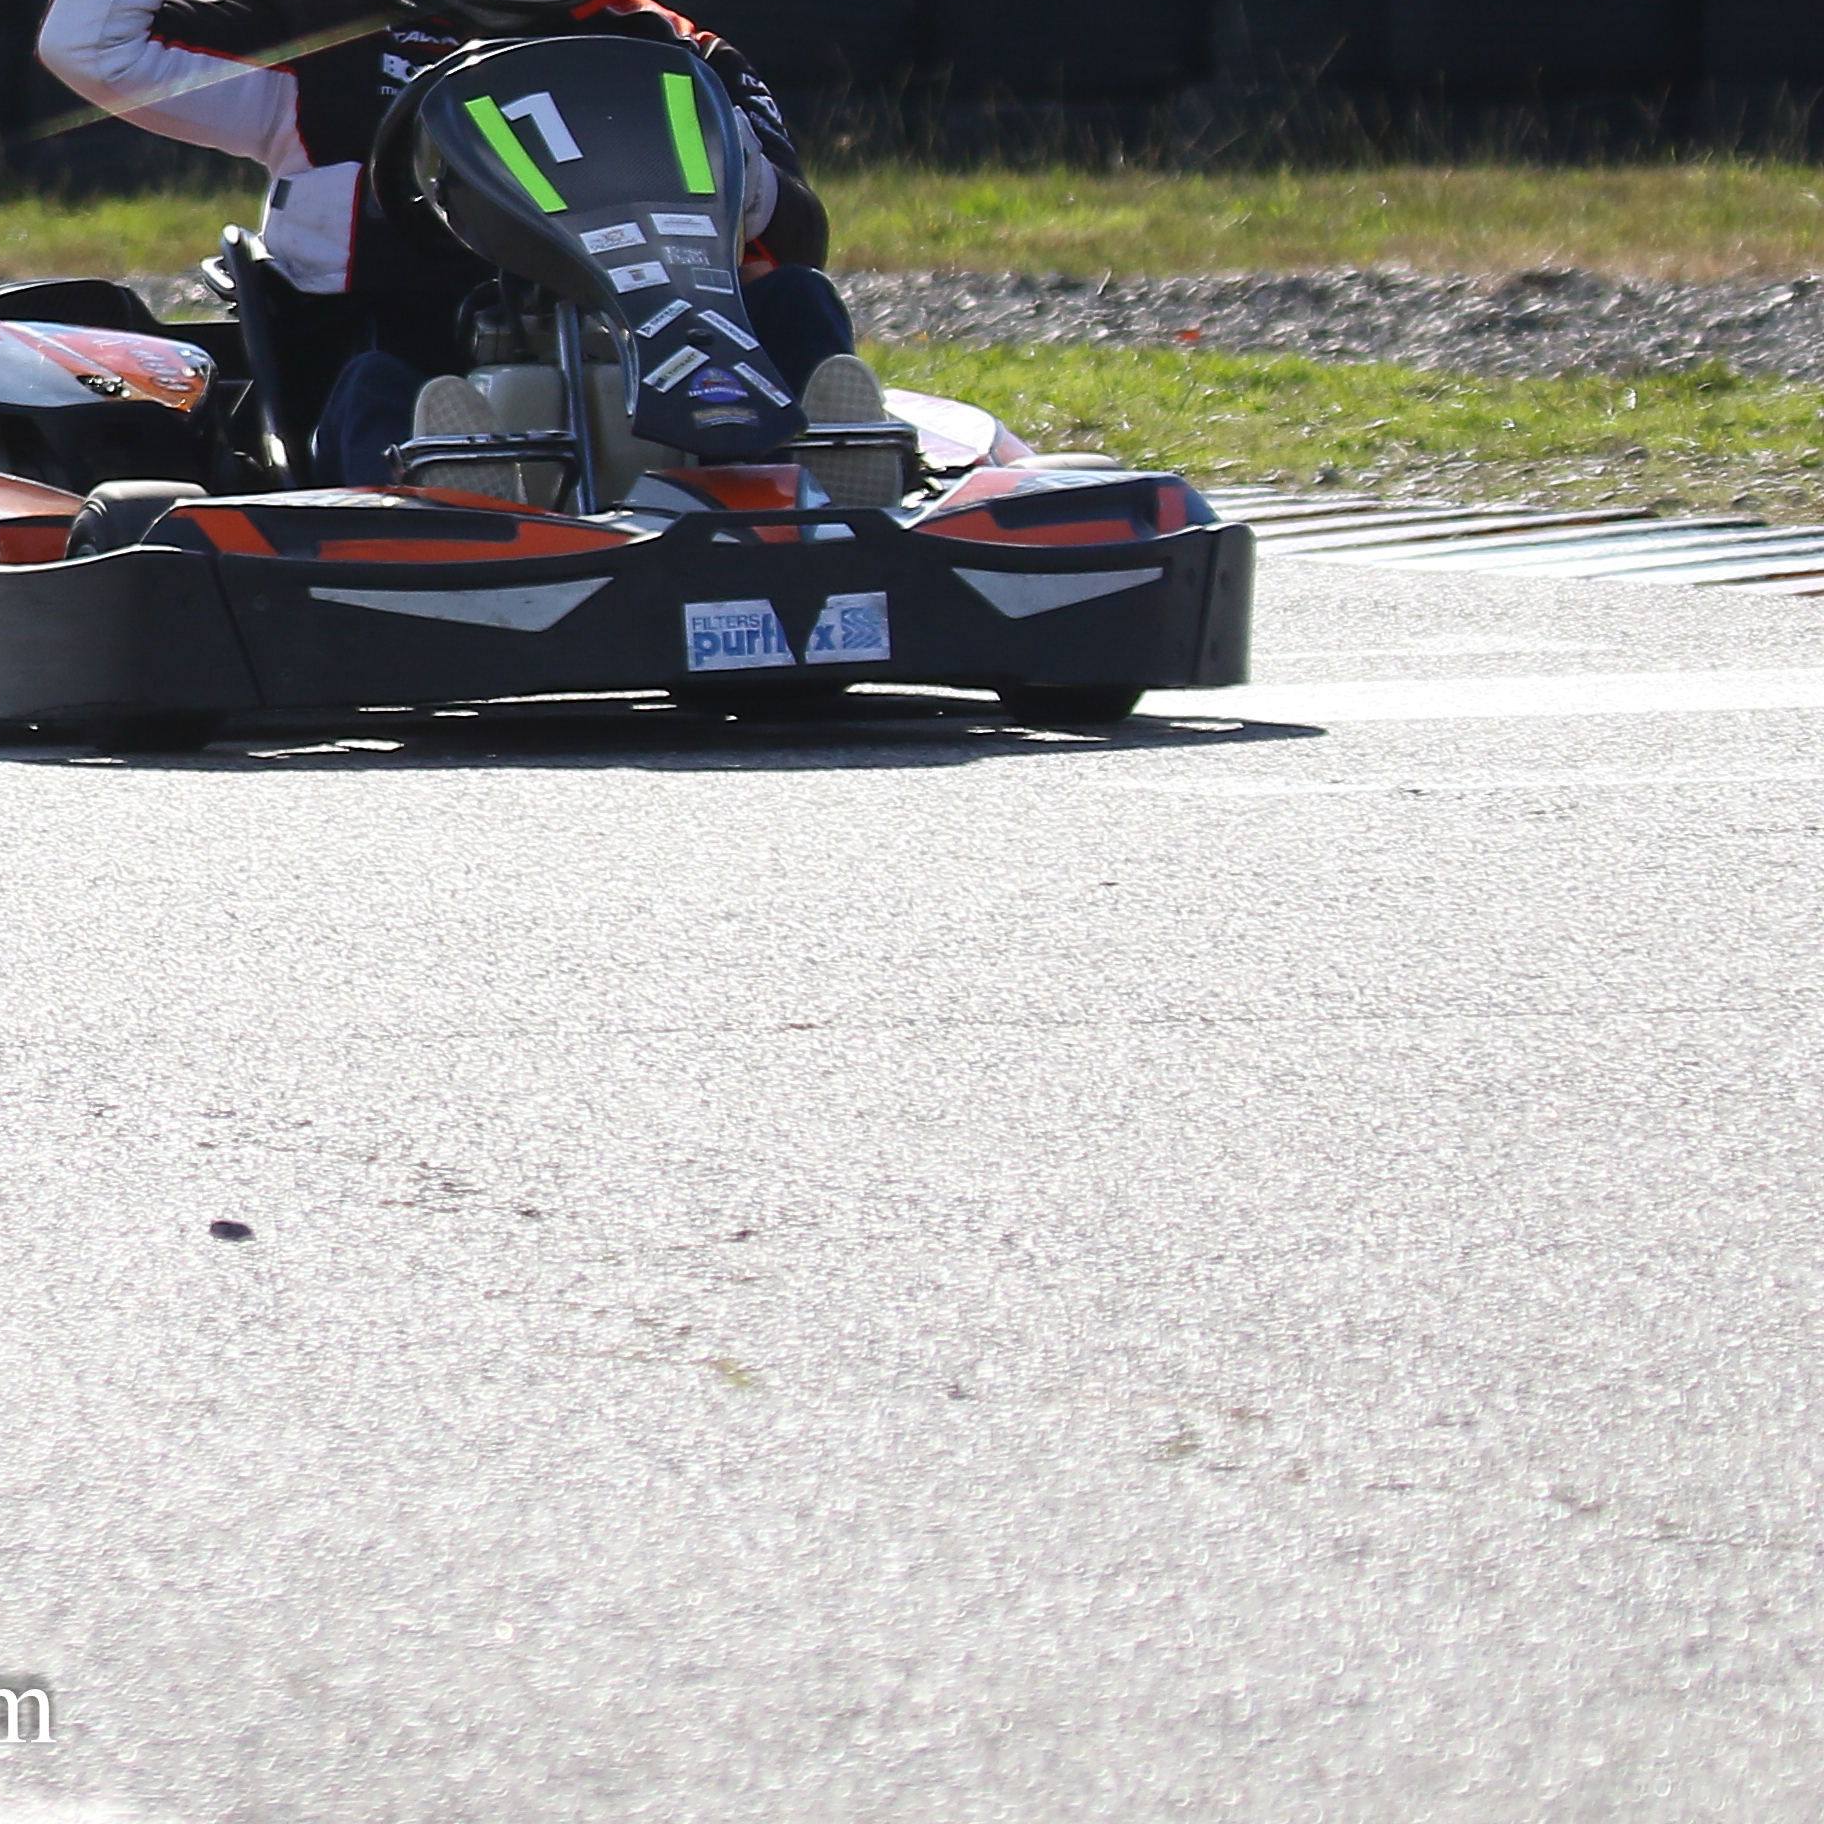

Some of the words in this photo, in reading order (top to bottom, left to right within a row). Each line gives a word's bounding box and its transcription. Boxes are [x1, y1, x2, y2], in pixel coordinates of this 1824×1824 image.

[501, 91, 584, 164] 1
[692, 614, 761, 631] FILTERS
[693, 613, 836, 668] purflx
